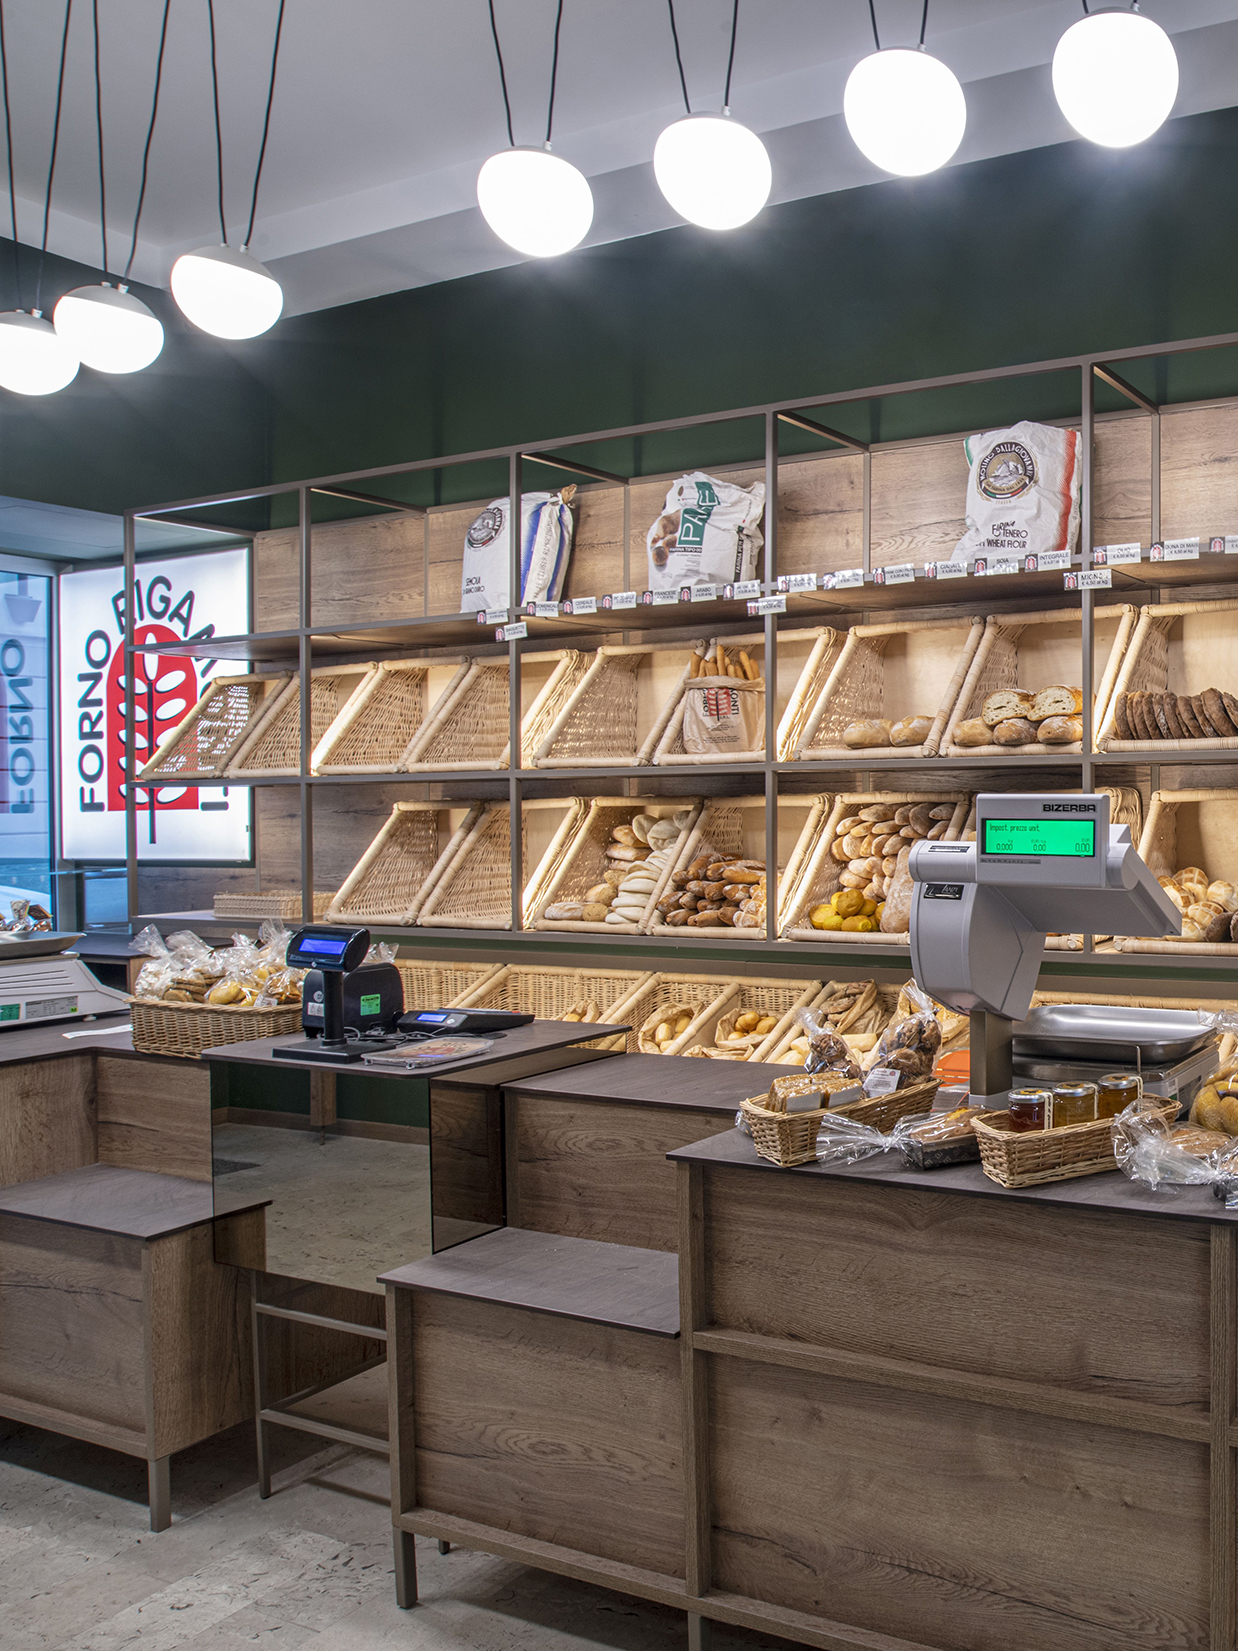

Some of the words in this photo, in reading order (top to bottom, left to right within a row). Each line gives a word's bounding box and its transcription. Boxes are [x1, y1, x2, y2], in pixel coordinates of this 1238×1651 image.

[1003, 528, 1028, 538] TENERO
[987, 539, 1006, 548] WHEAT
[1007, 540, 1027, 548] FLOUR
[1039, 552, 1069, 560] INTEGRALE
[1081, 572, 1110, 581] MIGNO
[505, 624, 525, 633] BAGUETTE
[78, 629, 112, 813] FORNO
[1043, 804, 1096, 812] BIZERBA
[989, 823, 1009, 832] Impost.
[1028, 824, 1041, 832] unit.
